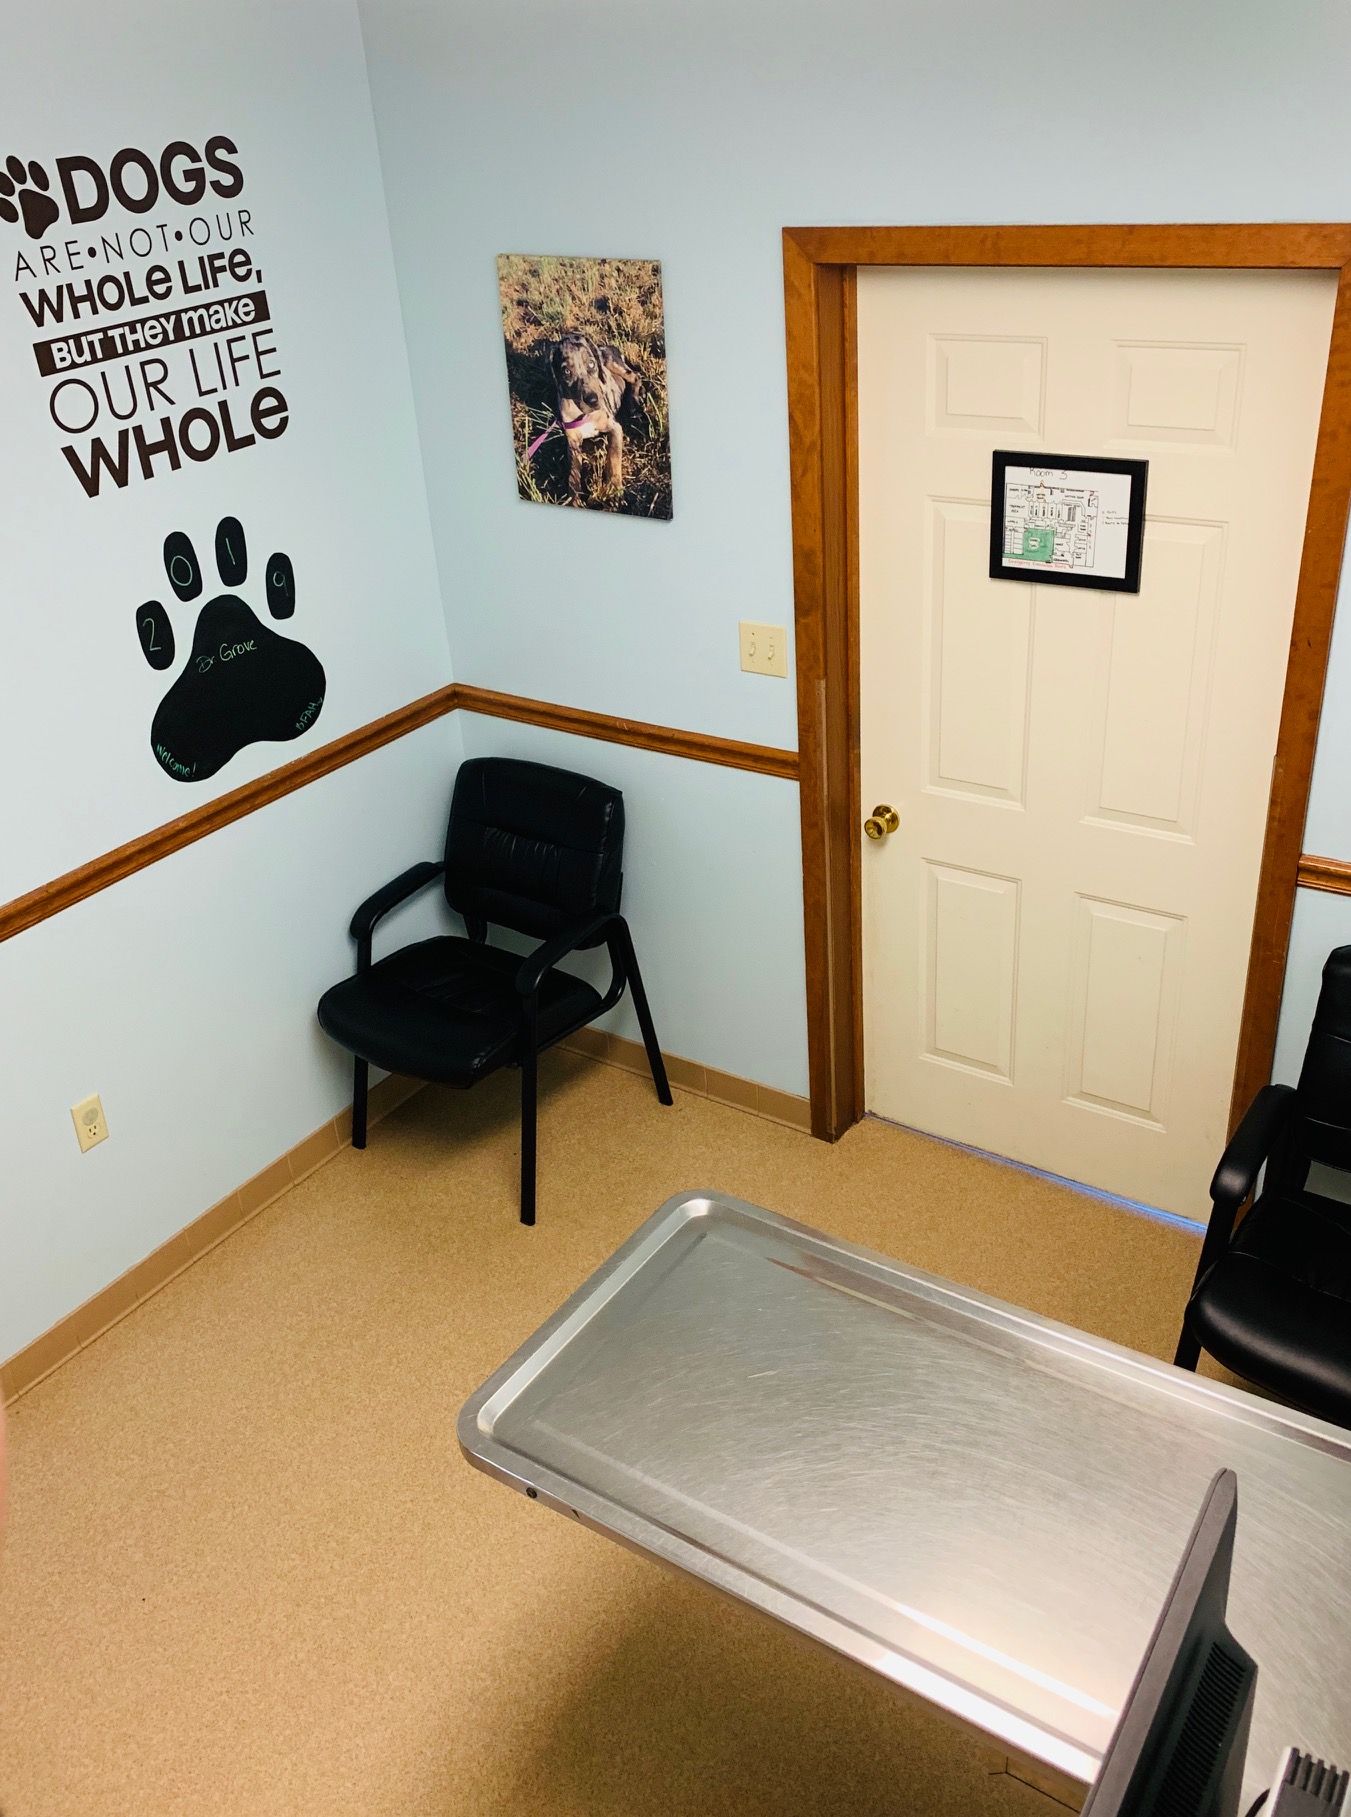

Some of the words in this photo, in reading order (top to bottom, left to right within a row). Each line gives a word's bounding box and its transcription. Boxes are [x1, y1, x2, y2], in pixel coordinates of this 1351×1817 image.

[56, 136, 244, 225] DOGS
[50, 332, 104, 370] BUT
[181, 297, 256, 338] make
[49, 357, 176, 434] OUR
[188, 328, 282, 398] LIFE
[219, 640, 257, 661] Grove
